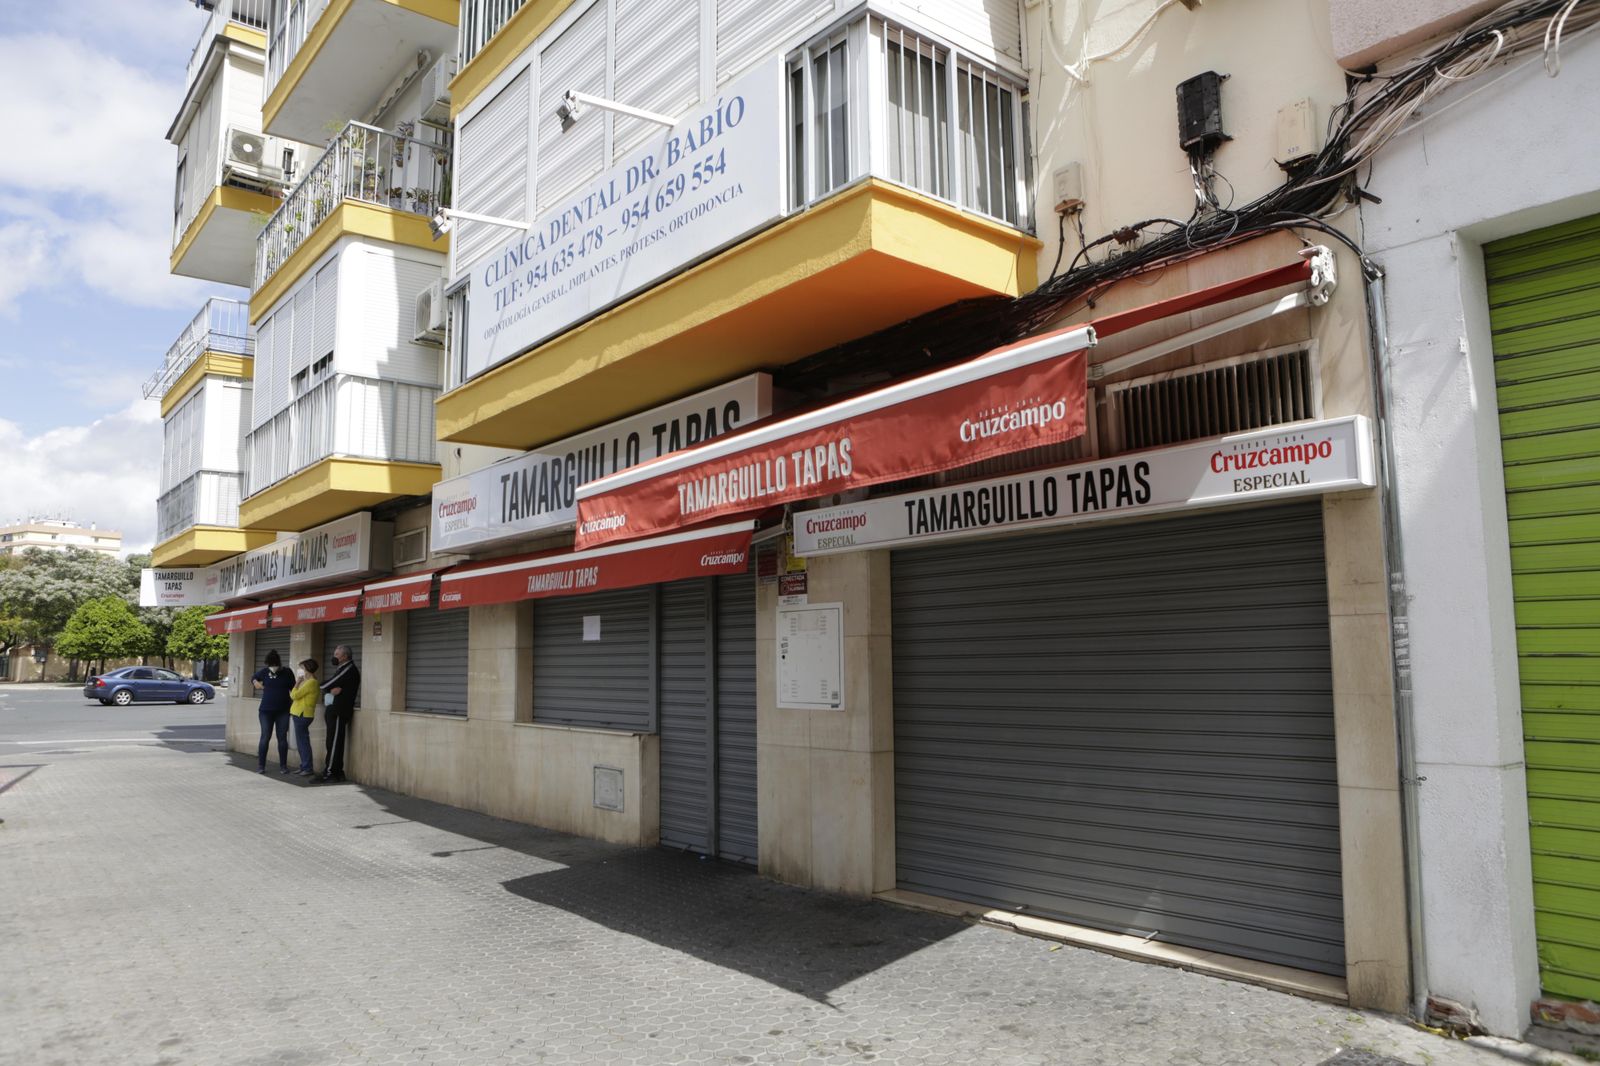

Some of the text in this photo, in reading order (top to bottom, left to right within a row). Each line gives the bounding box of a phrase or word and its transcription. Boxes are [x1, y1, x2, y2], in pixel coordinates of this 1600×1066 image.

[485, 96, 745, 287] CLÍNICA DENTAL DR. BABÍO
[494, 279, 523, 312] TLF:
[526, 260, 548, 293] 954
[552, 243, 575, 277] 635
[578, 225, 603, 258] 478
[622, 195, 650, 235] 954
[655, 173, 686, 213] 659
[692, 147, 726, 191] 554
[484, 303, 532, 340] ODONTOLOGÍA
[669, 183, 743, 233] ORTODONCIA
[960, 399, 1066, 443] Cruzcampo
[1210, 440, 1332, 474] Cruzcampo
[678, 438, 853, 515] TAMARGUILLO TAPAS
[1233, 470, 1311, 493] ESPECIAL
[438, 497, 477, 518] Cruzcampo
[904, 461, 1151, 536] TAMARGUILLO TAPAS
[579, 514, 626, 536] Cruzcampo
[806, 514, 867, 535] Cruzcampo
[282, 546, 288, 578] Y
[309, 532, 329, 572] MÁS
[817, 534, 857, 549] ESPECIAL
[700, 552, 745, 567] Cruzcampo
[154, 571, 194, 581] TAMARGUILLO
[164, 582, 183, 591] TAPAS
[527, 566, 599, 593] TAMARGUILLO TAPAS
